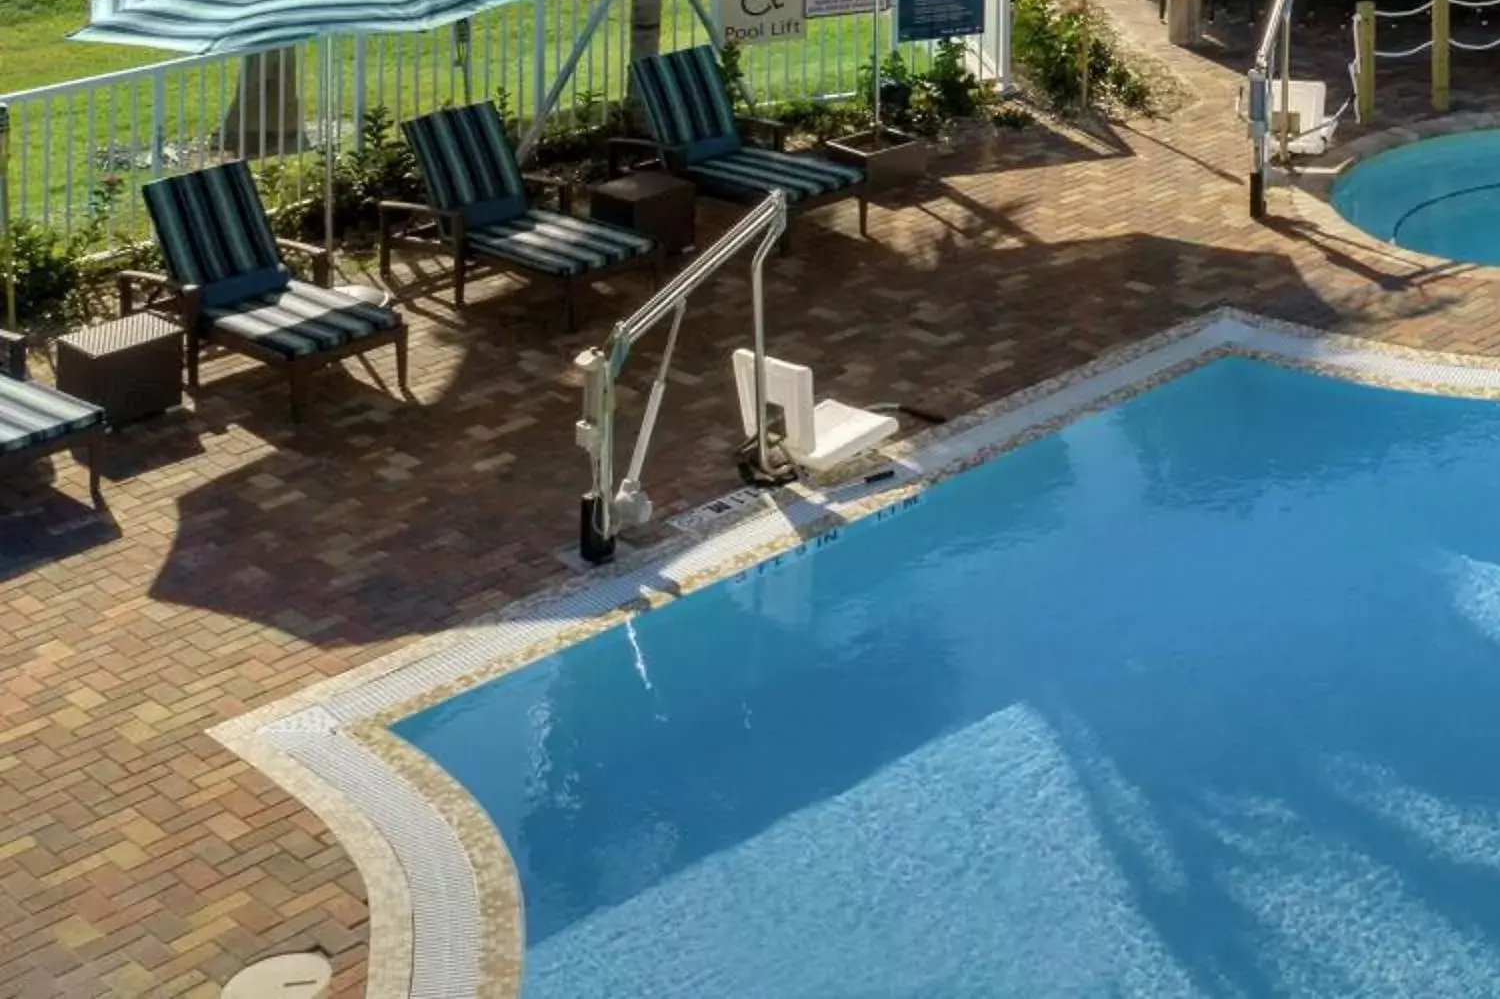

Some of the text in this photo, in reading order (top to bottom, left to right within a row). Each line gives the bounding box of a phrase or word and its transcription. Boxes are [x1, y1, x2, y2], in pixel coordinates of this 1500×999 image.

[725, 18, 801, 40] Pool Lift
[816, 529, 838, 548] IN
